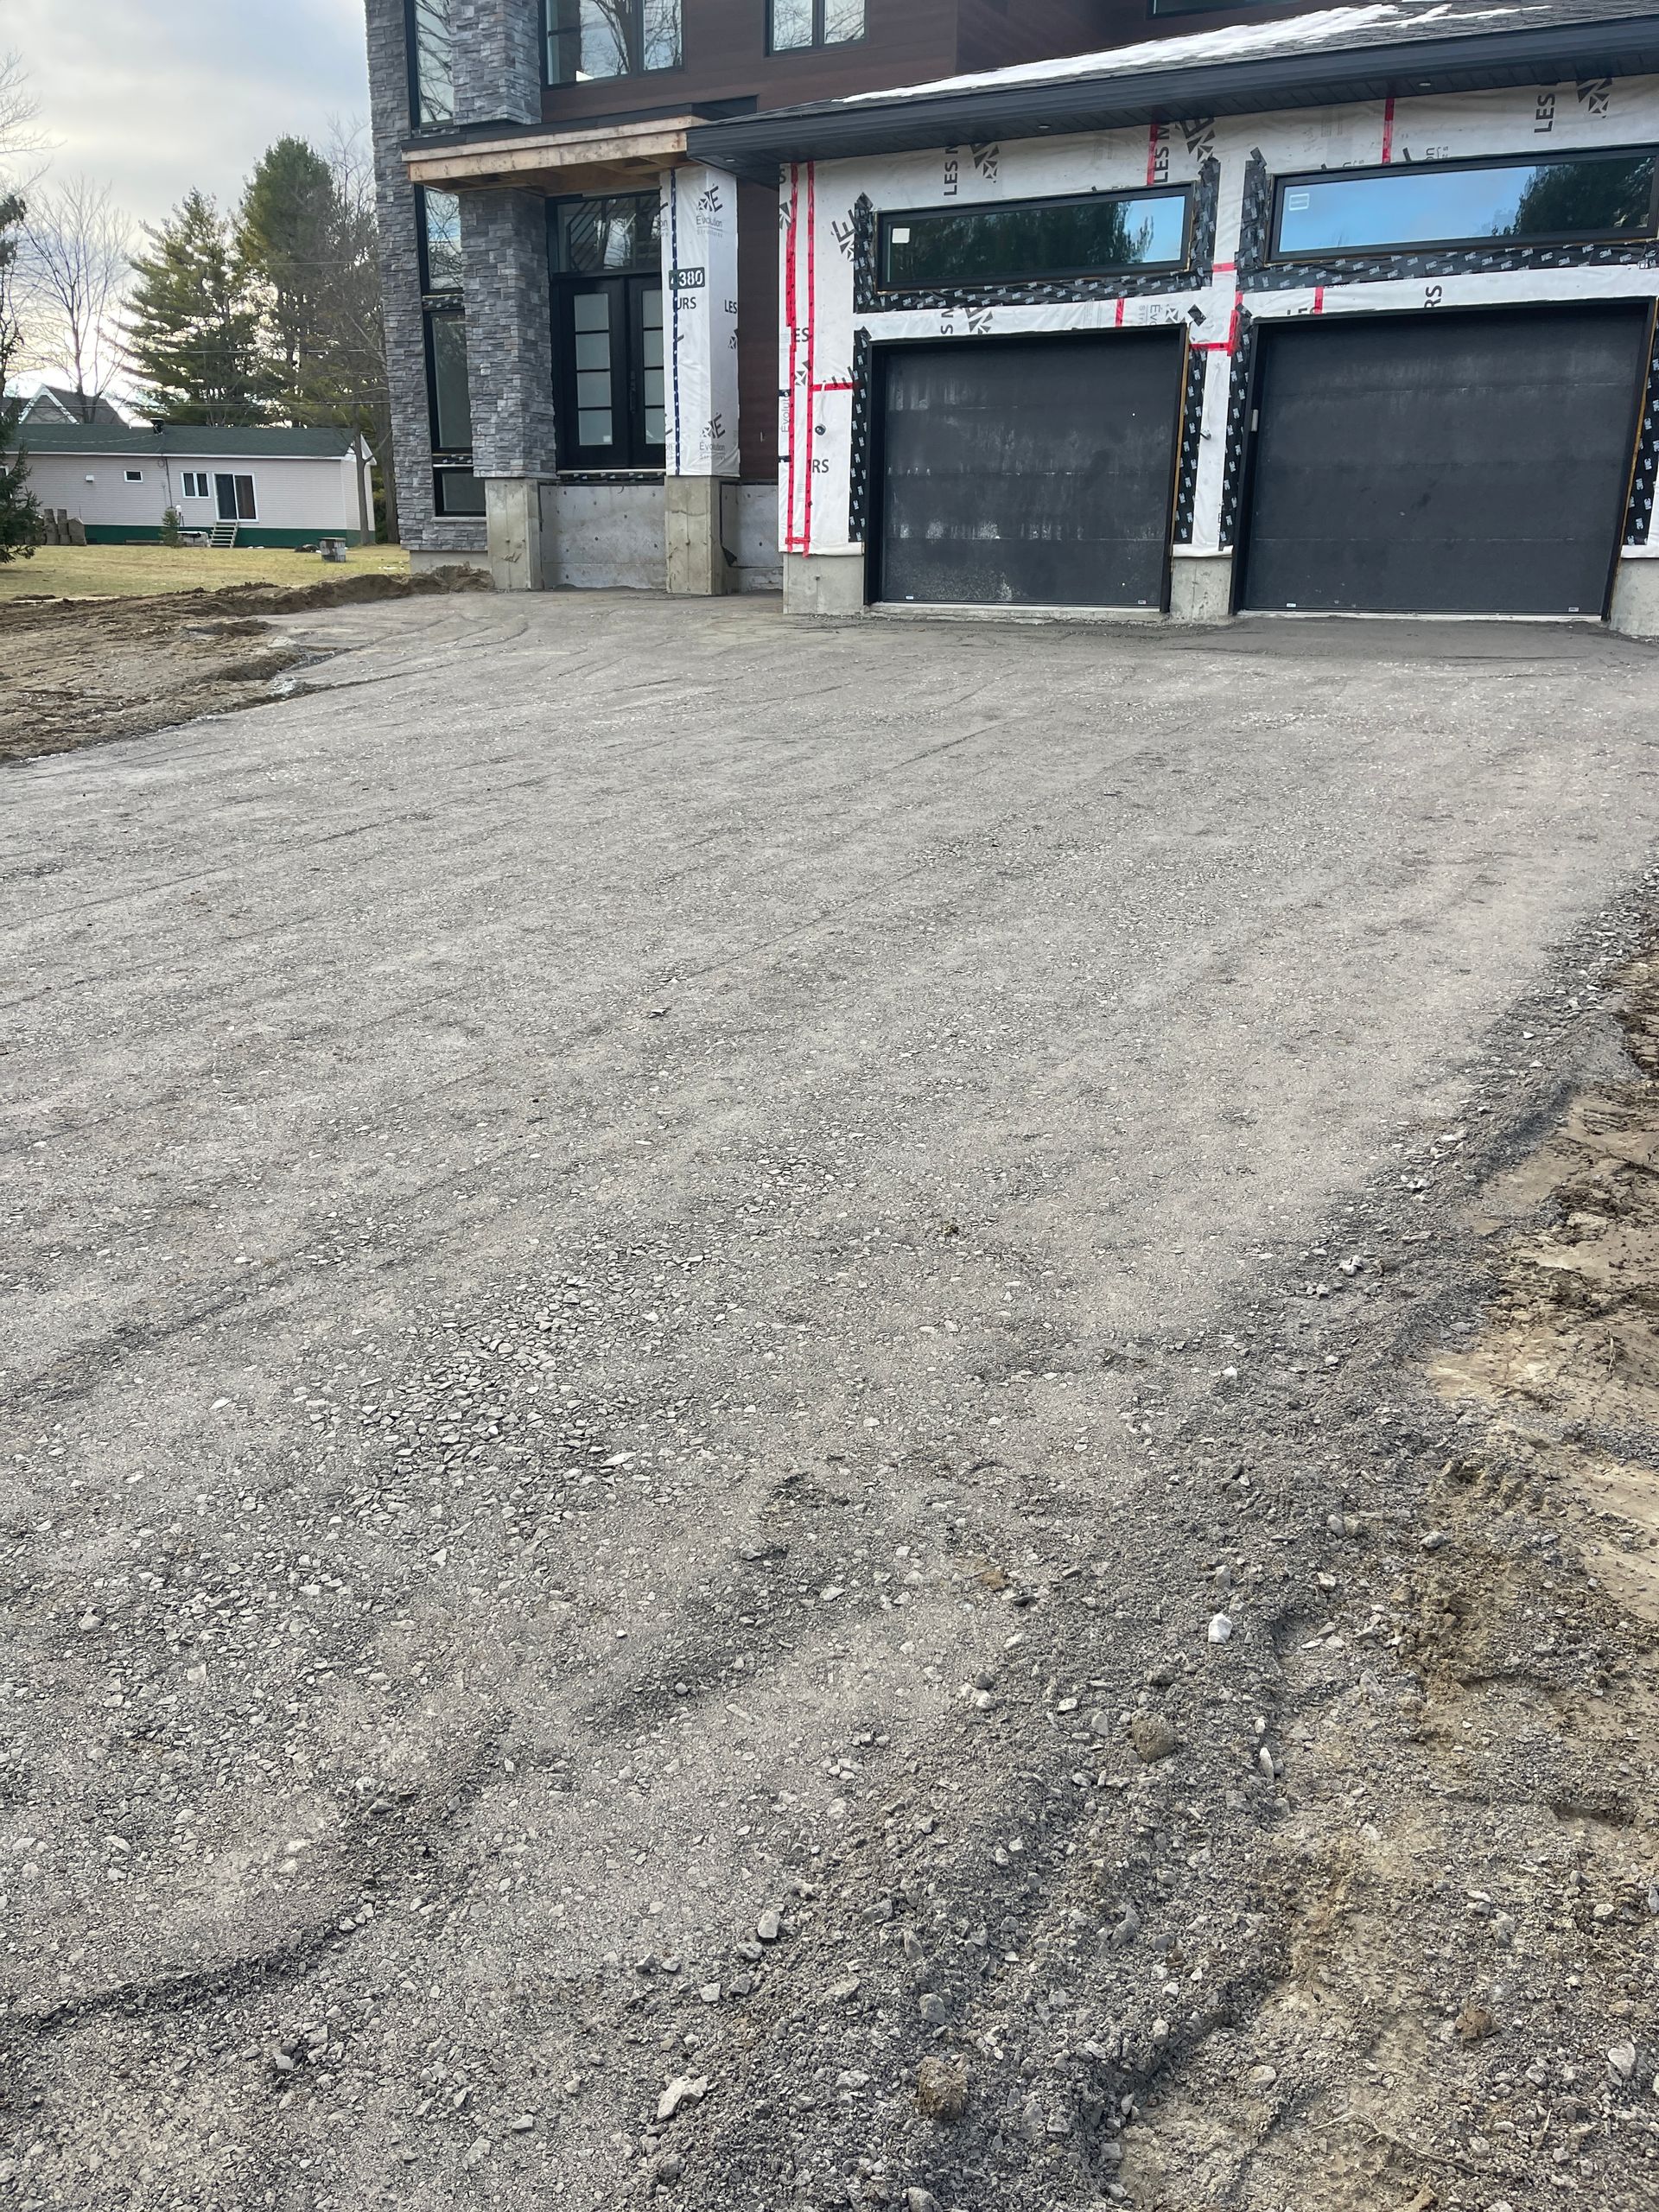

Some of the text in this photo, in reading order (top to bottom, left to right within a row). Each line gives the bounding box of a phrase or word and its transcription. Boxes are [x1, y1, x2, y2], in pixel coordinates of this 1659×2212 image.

[1534, 92, 1555, 134] LES
[944, 160, 958, 196] LES
[1154, 146, 1170, 183] LES
[725, 299, 737, 315] LES
[812, 458, 830, 474] RS
